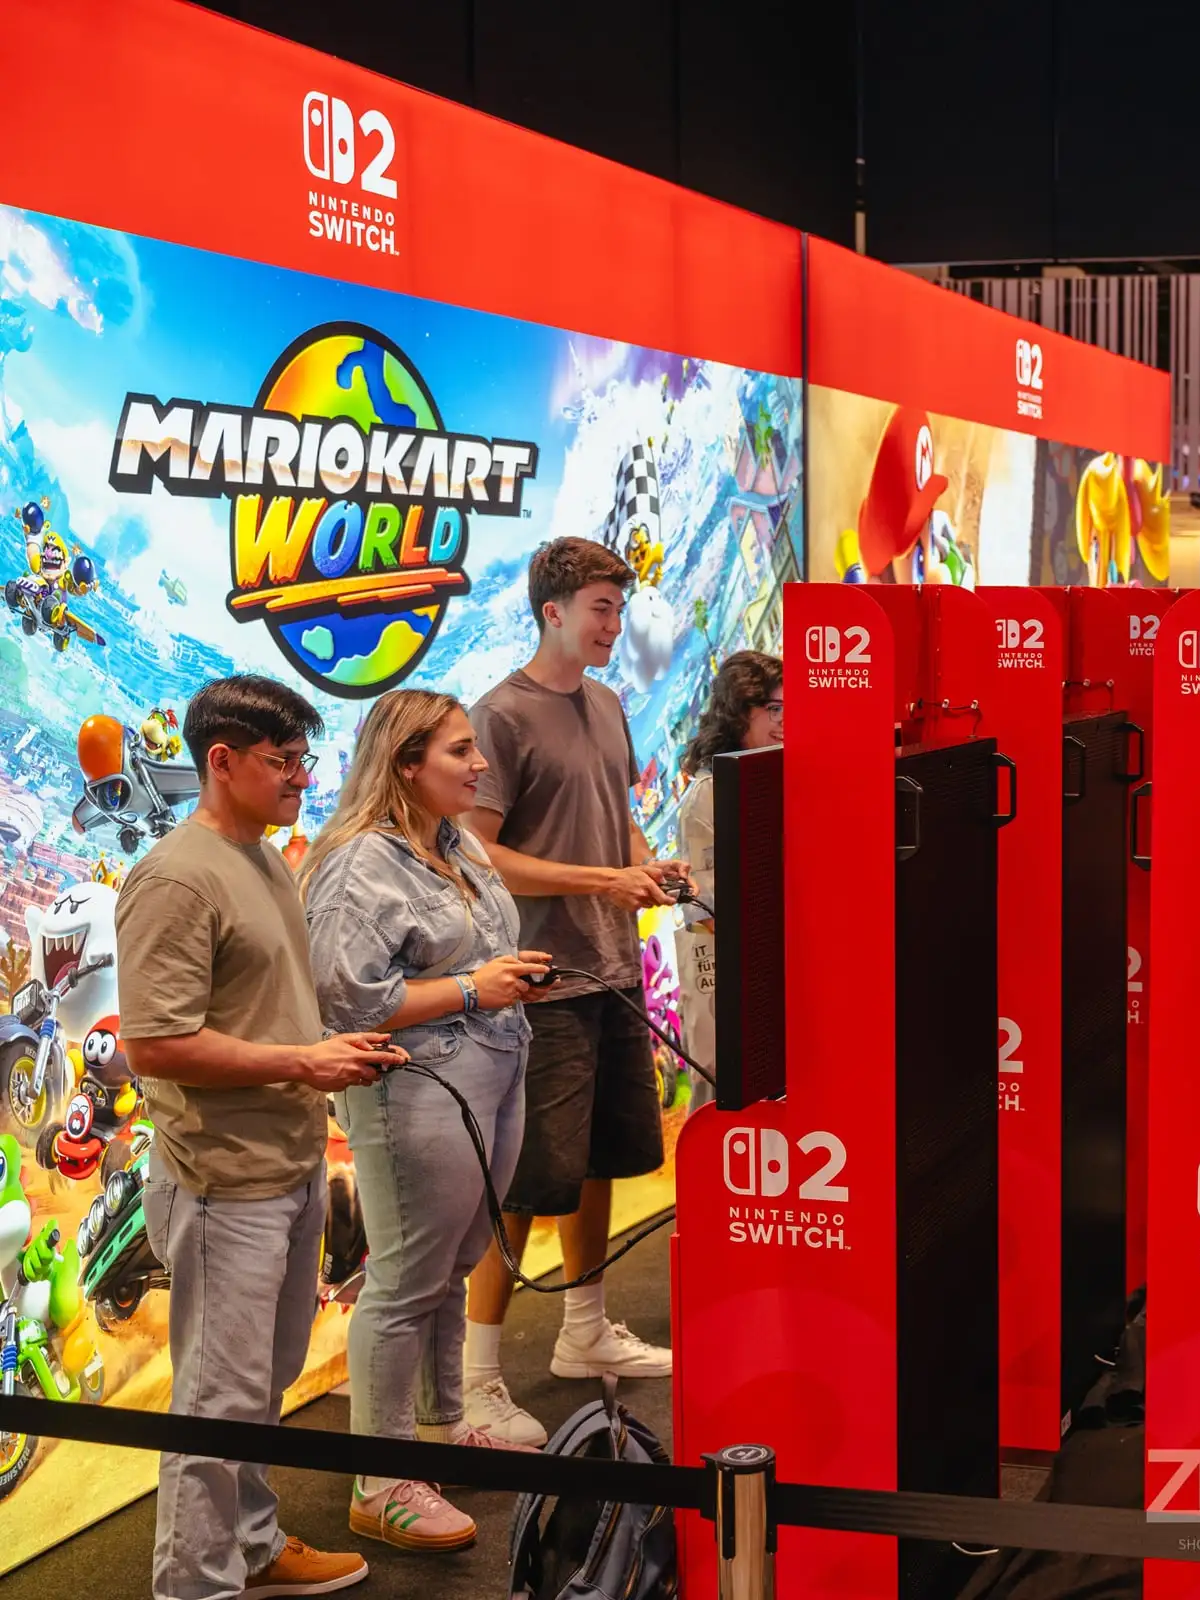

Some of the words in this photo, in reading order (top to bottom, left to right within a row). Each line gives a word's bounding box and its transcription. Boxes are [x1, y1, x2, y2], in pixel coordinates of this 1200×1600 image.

[359, 110, 397, 199] 2
[309, 191, 394, 226] NINTENDO
[1031, 344, 1043, 390] 2
[235, 493, 463, 590] WORLD
[844, 626, 871, 663] 2
[1023, 619, 1044, 648] 2
[796, 1131, 849, 1202] 2
[729, 1207, 845, 1225] NINTENDO
